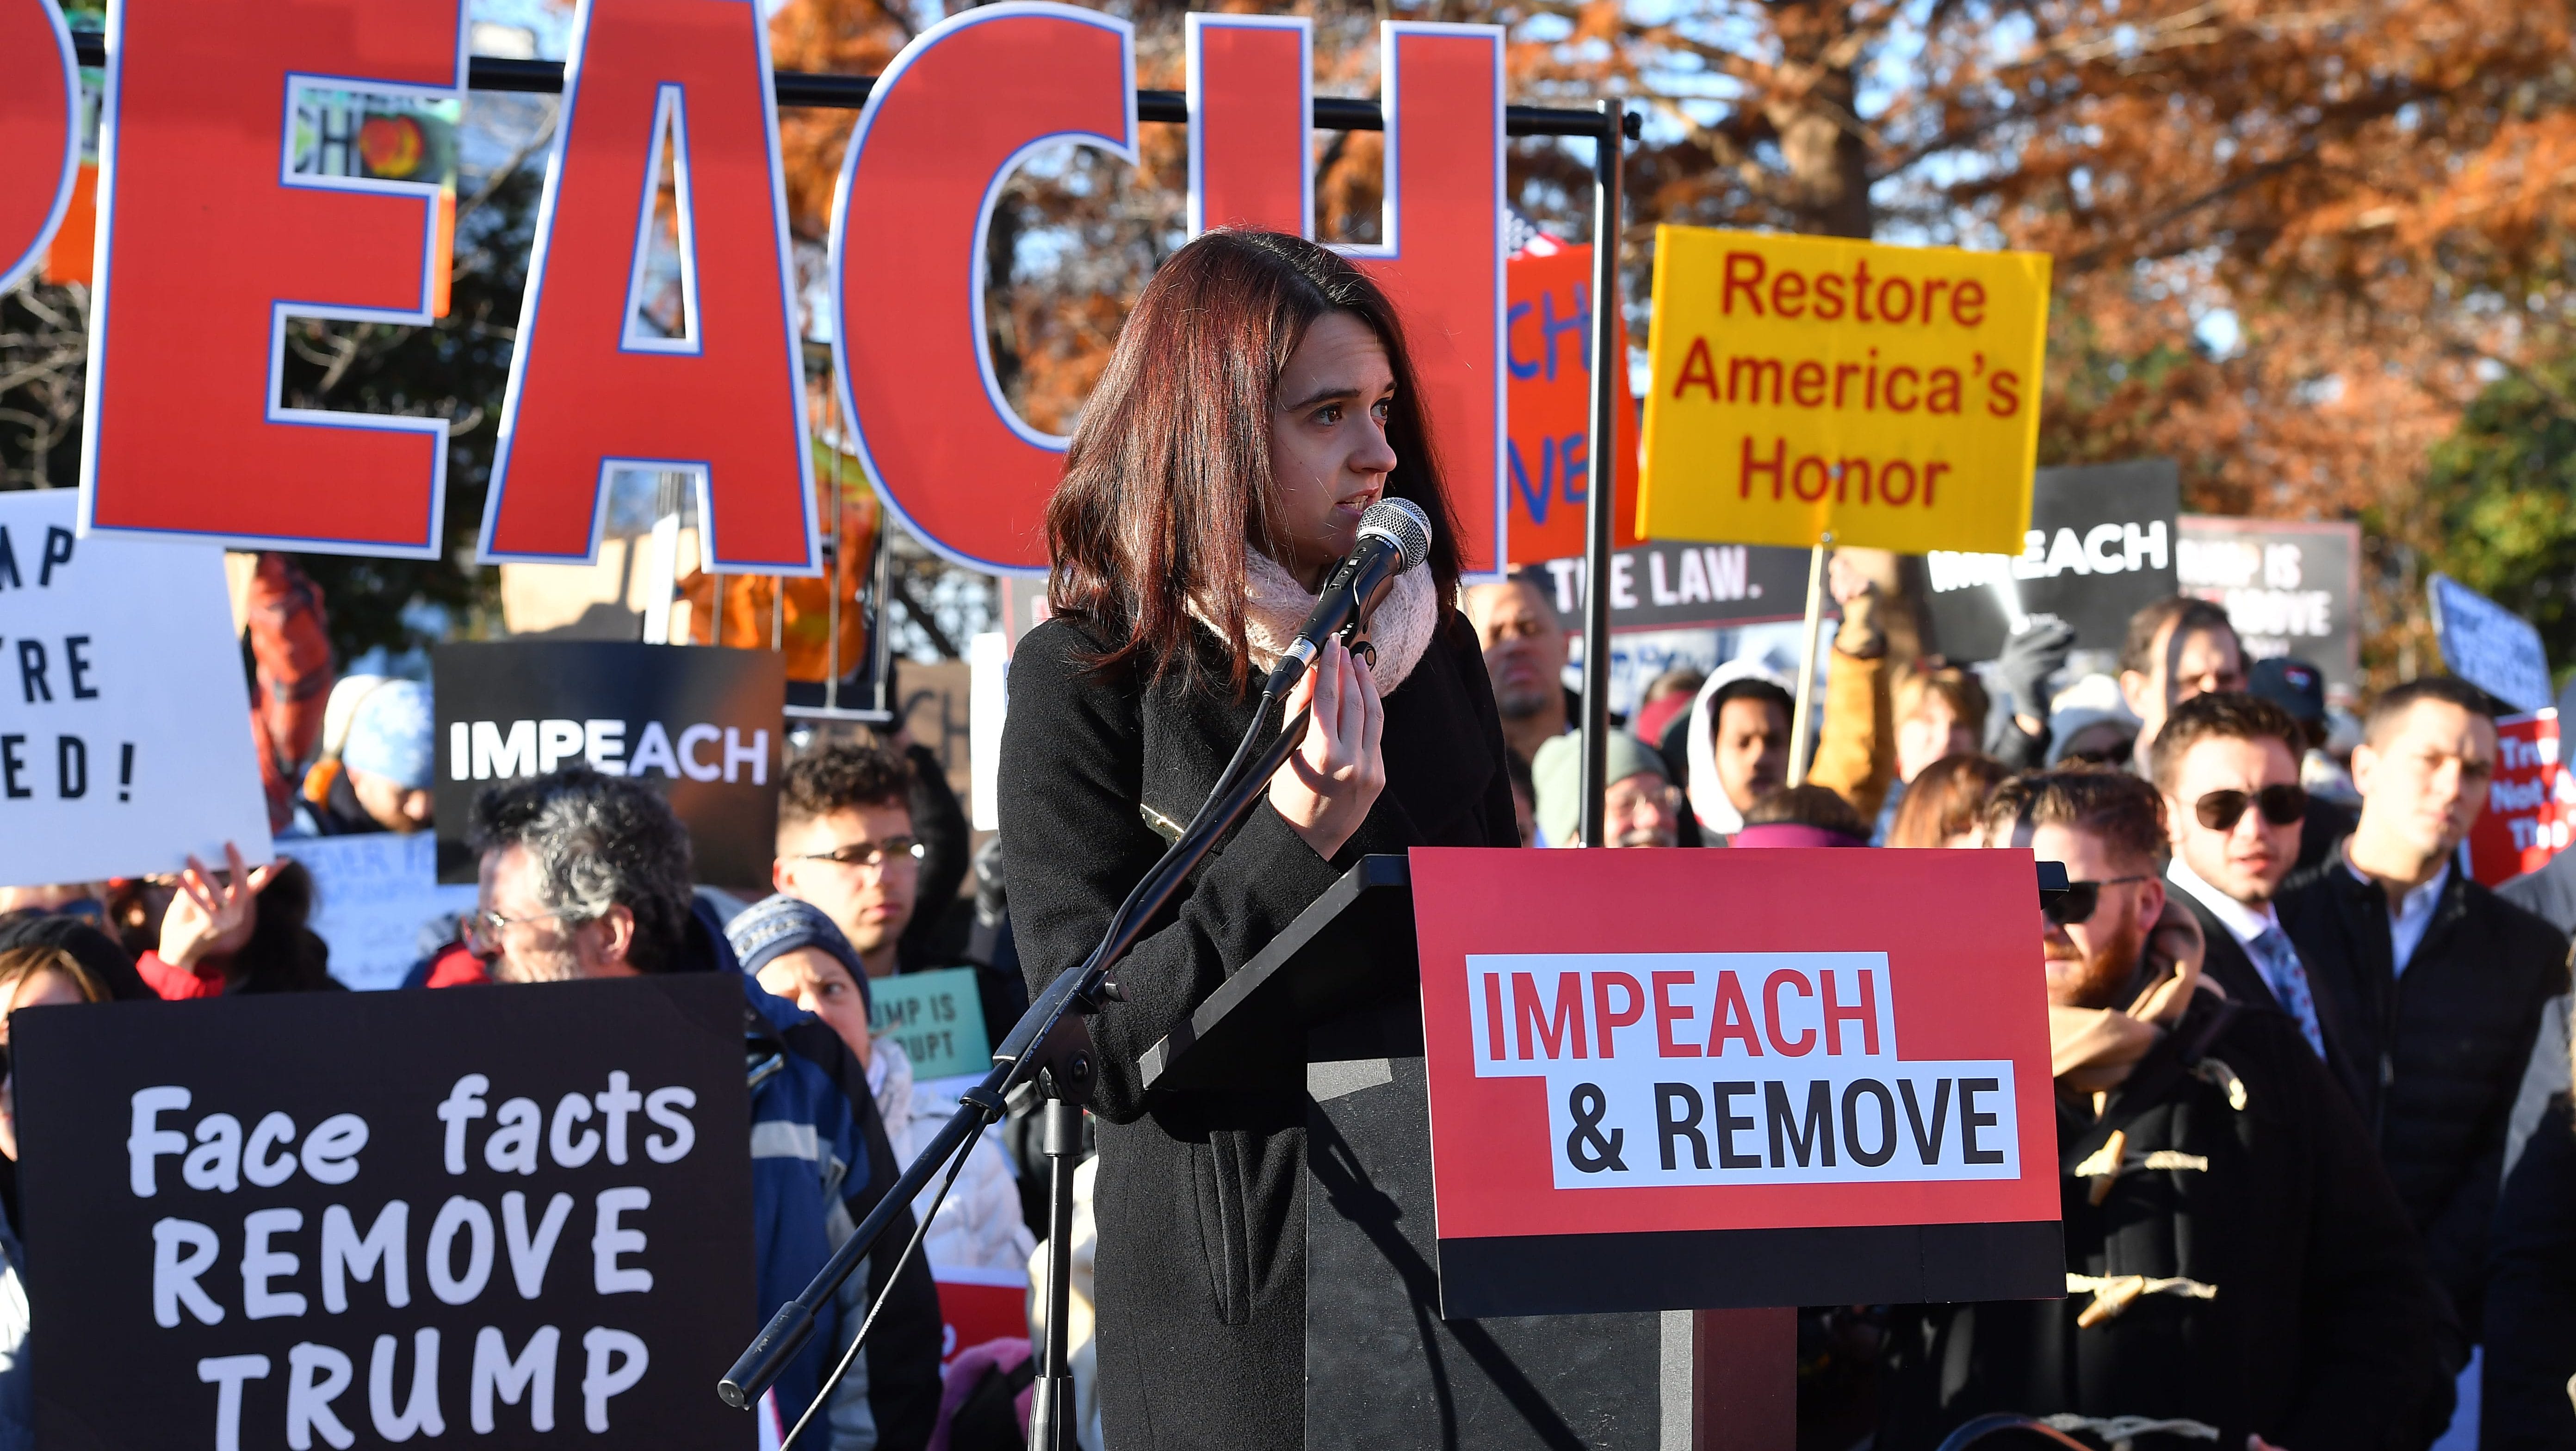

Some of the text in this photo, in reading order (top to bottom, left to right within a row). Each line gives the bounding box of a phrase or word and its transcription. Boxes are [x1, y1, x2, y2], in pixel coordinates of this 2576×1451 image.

[1721, 251, 1987, 327] Restore
[1672, 335, 2020, 418] America's
[1739, 436, 1952, 508] Honor
[450, 718, 769, 786] IMPEACH
[1483, 968, 1880, 1061] IMPEACH
[127, 1070, 697, 1198] Face facts
[1566, 1077, 2005, 1173] & REMOVE
[151, 1186, 654, 1328] REMOVE
[197, 1325, 650, 1451] TRUMP
